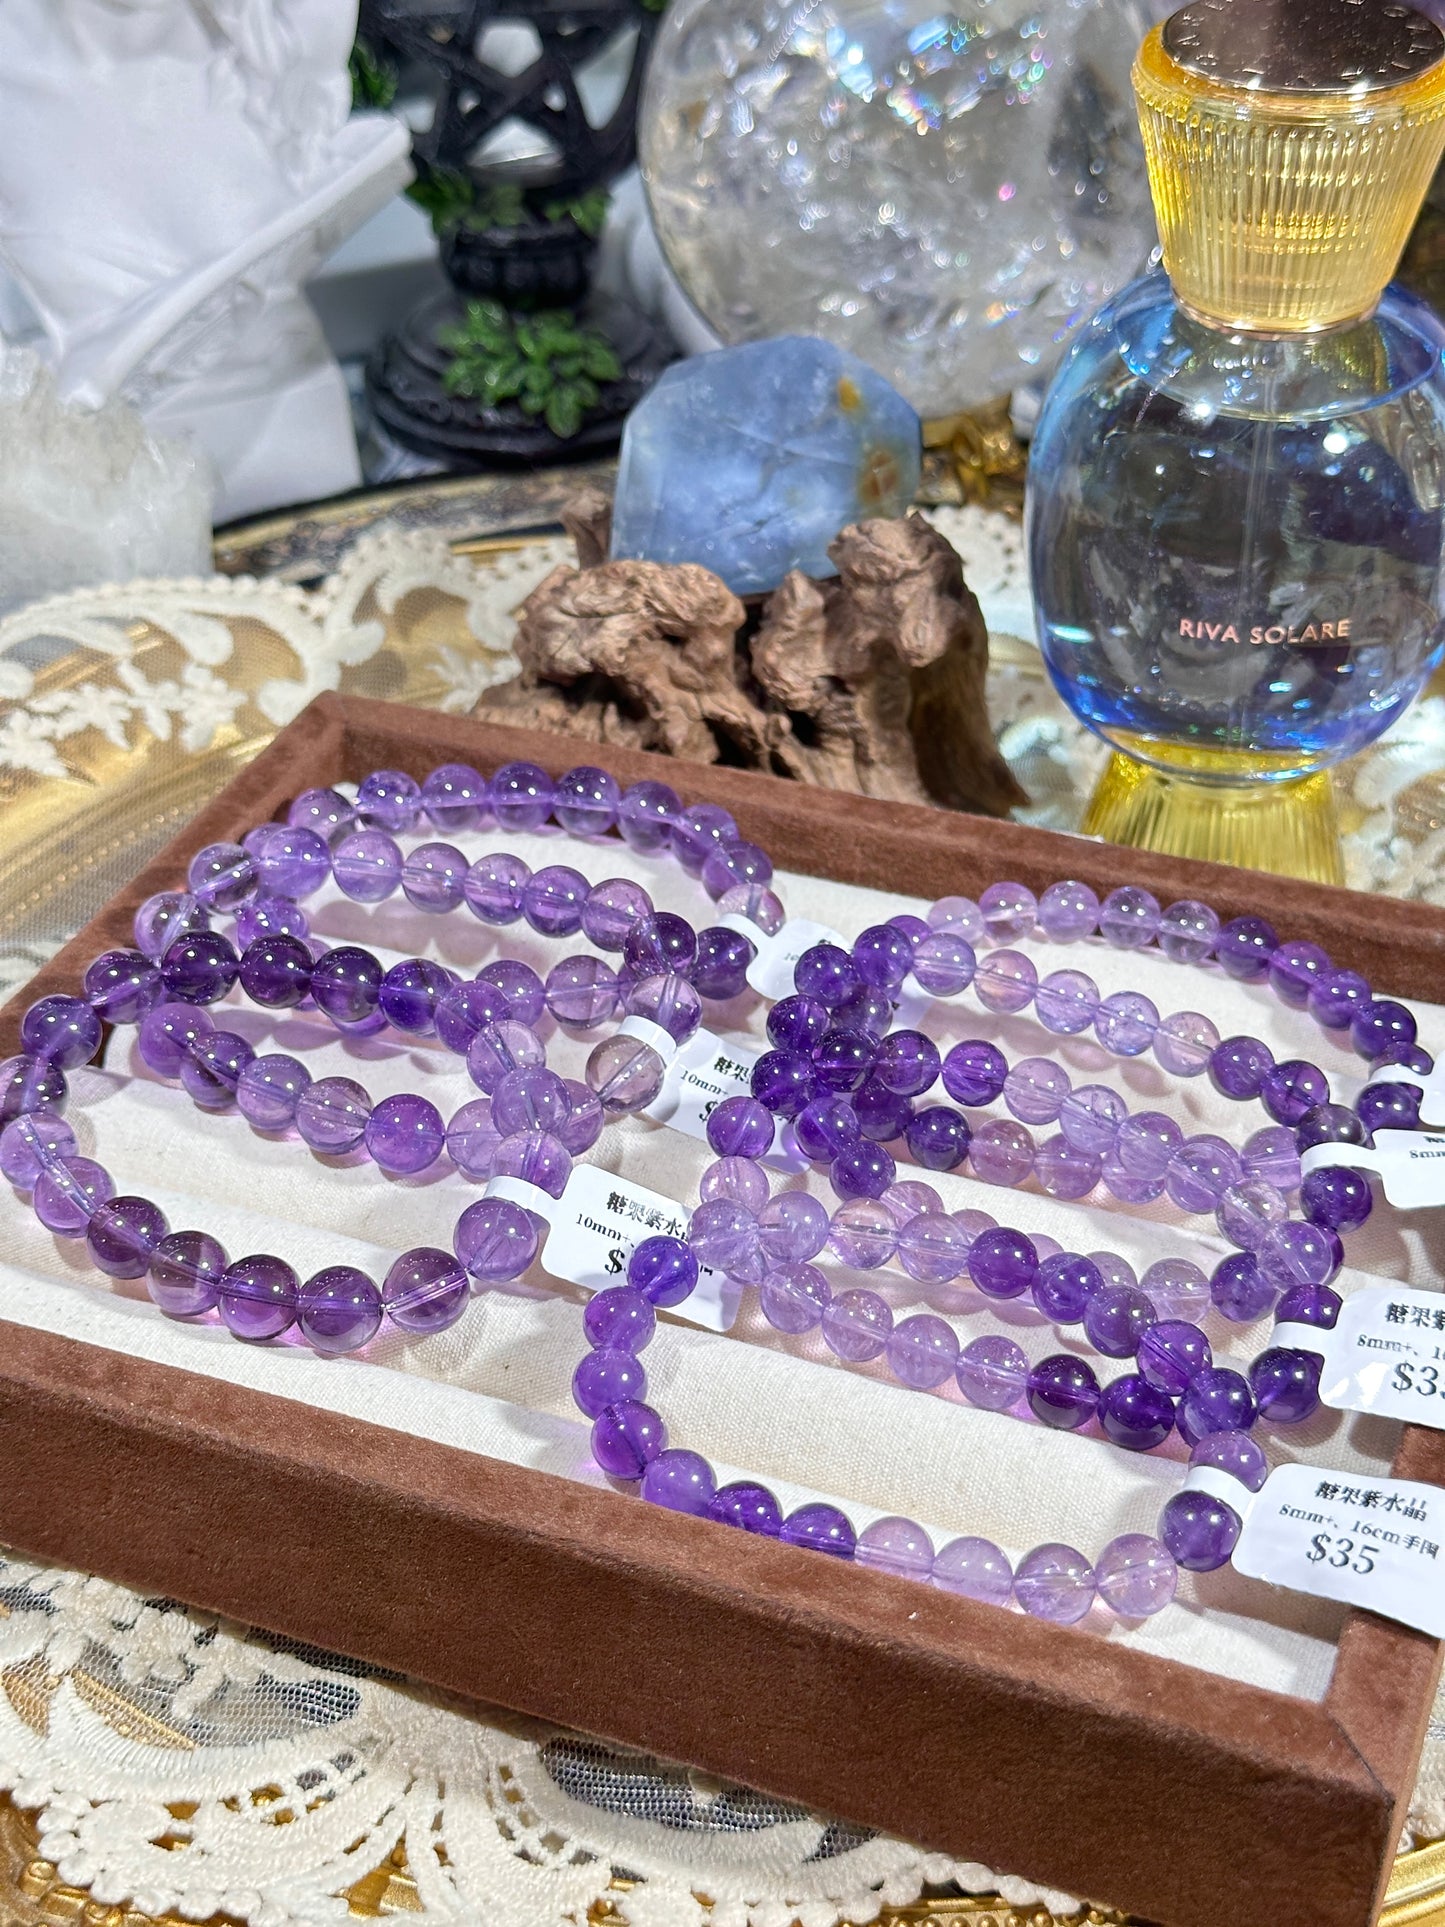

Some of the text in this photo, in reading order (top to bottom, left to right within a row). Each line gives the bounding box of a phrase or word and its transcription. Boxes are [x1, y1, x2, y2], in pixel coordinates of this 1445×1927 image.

[1179, 617, 1352, 645] RIVA SOLARE
[714, 1056, 751, 1084] 糖果
[606, 1191, 688, 1242] 糖果紫水
[1391, 1360, 1445, 1400] $3
[1315, 1480, 1428, 1522] 糖果紫水晶
[1305, 1531, 1380, 1575] $35
